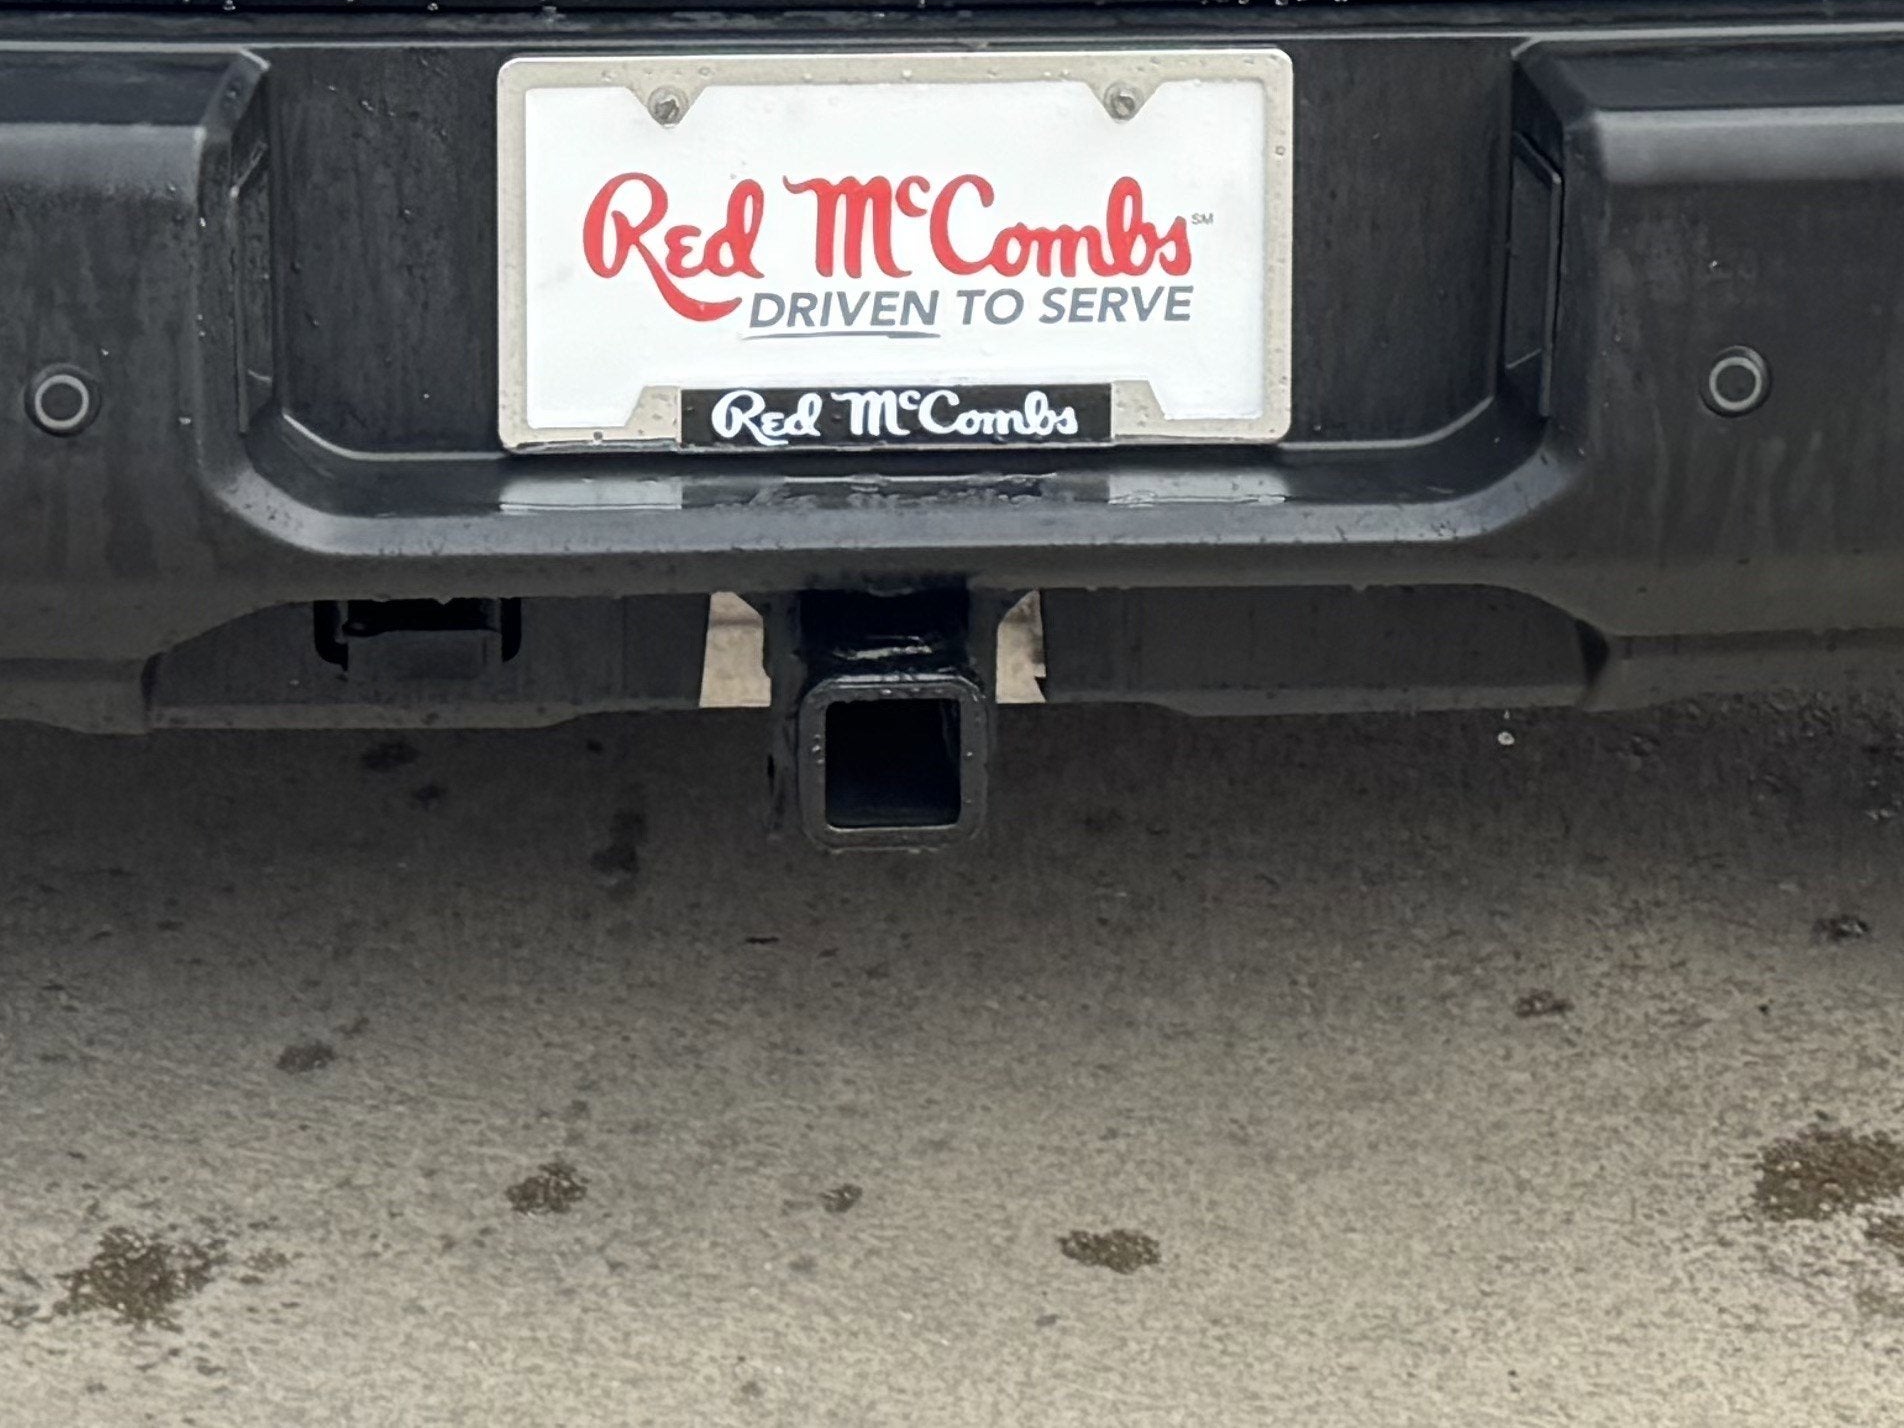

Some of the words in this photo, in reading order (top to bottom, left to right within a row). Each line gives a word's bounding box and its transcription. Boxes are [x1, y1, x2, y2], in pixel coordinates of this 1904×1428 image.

[582, 171, 765, 323] Red
[782, 173, 1192, 279] McCombs
[749, 289, 940, 329] DRIVEN
[956, 287, 1024, 327] TO
[1039, 284, 1194, 324] SERVE
[710, 389, 821, 446] Red
[830, 388, 1079, 440] McCombs
